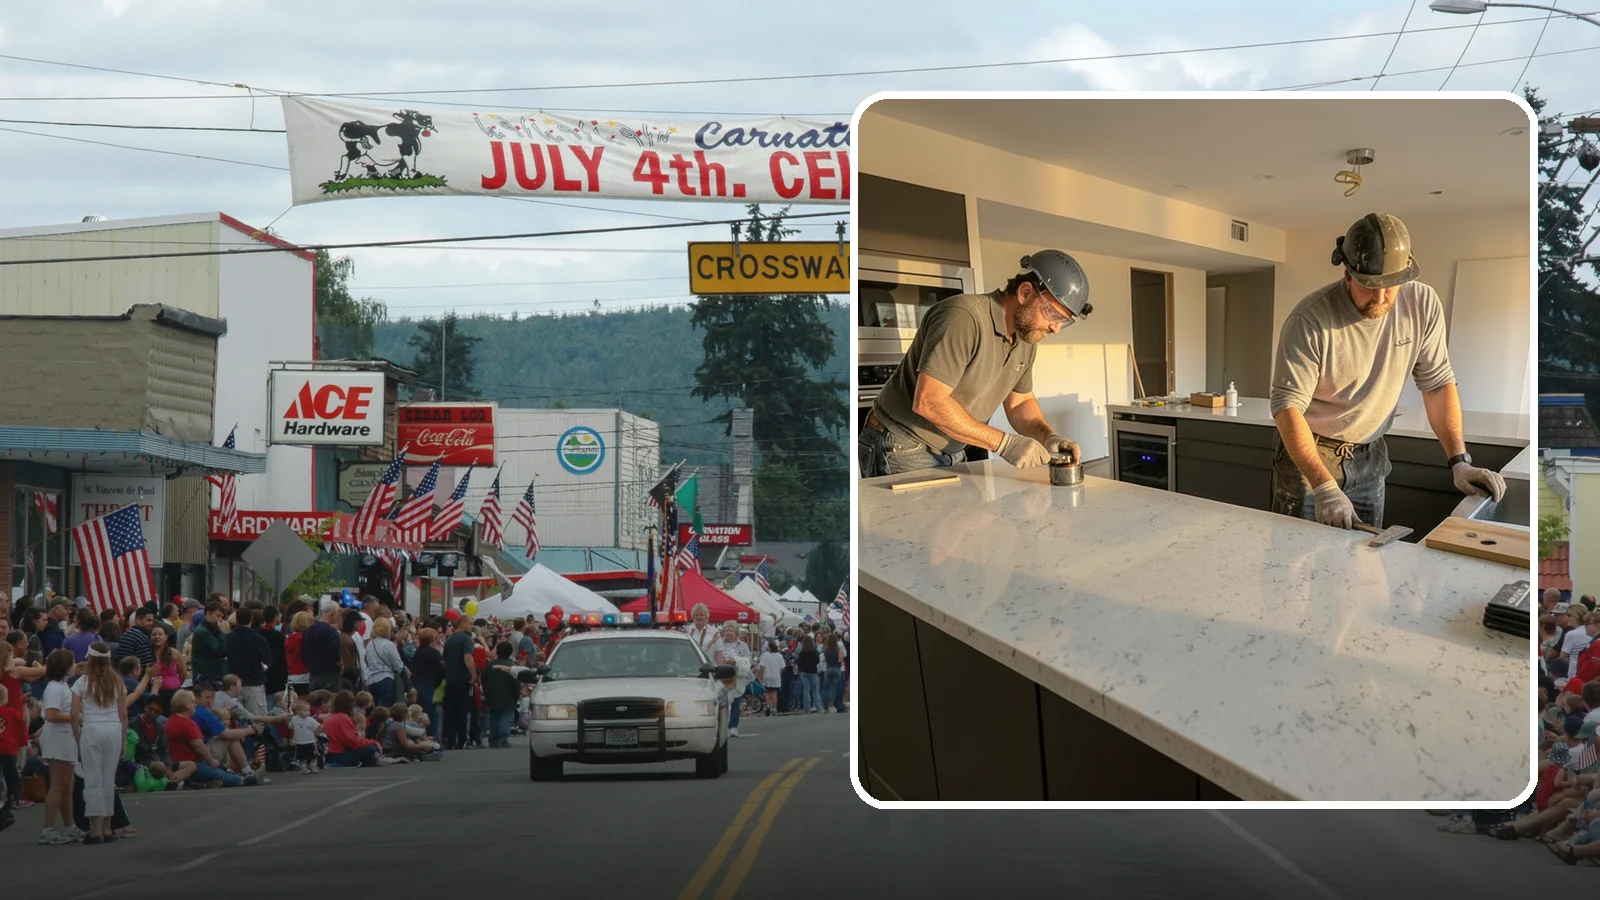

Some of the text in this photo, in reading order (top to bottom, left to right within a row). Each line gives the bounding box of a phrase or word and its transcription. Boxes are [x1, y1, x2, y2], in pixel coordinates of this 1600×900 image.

[481, 141, 604, 192] JULY
[632, 151, 746, 197] 4th.
[697, 254, 850, 280] CROSSWA
[283, 380, 373, 420] ACE
[406, 409, 485, 422] CEDAR LOG
[283, 421, 371, 436] Hardware
[416, 428, 477, 447] Coca-Cola
[354, 467, 385, 480] Simpl
[96, 485, 124, 495] Vincent
[126, 486, 135, 495] de
[138, 485, 155, 495] Paul
[688, 526, 742, 535] CRNATION
[699, 535, 730, 543] GLASS
